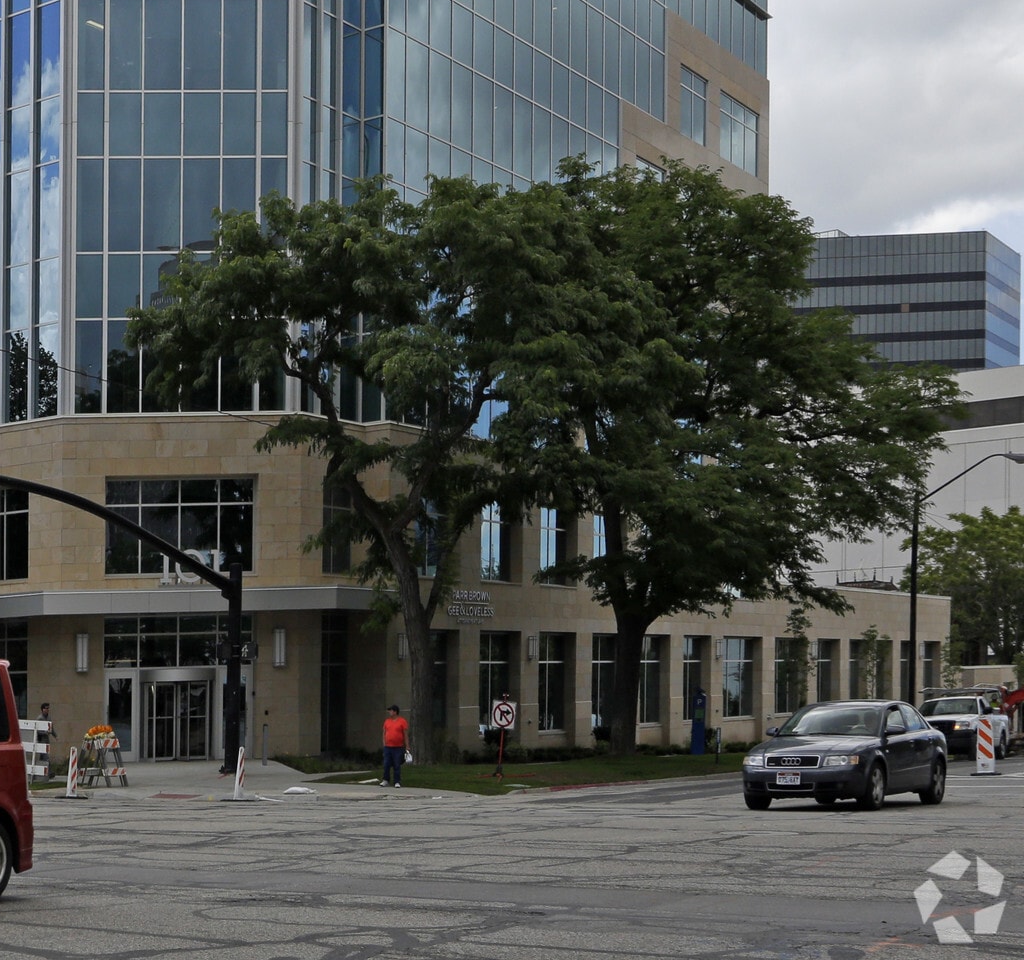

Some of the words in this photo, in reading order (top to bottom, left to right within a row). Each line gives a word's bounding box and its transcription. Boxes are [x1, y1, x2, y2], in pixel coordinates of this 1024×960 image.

[452, 590, 468, 600] PARR
[468, 591, 491, 601] BROWN
[447, 605, 459, 616] GEE
[466, 606, 495, 617] LOVELESS
